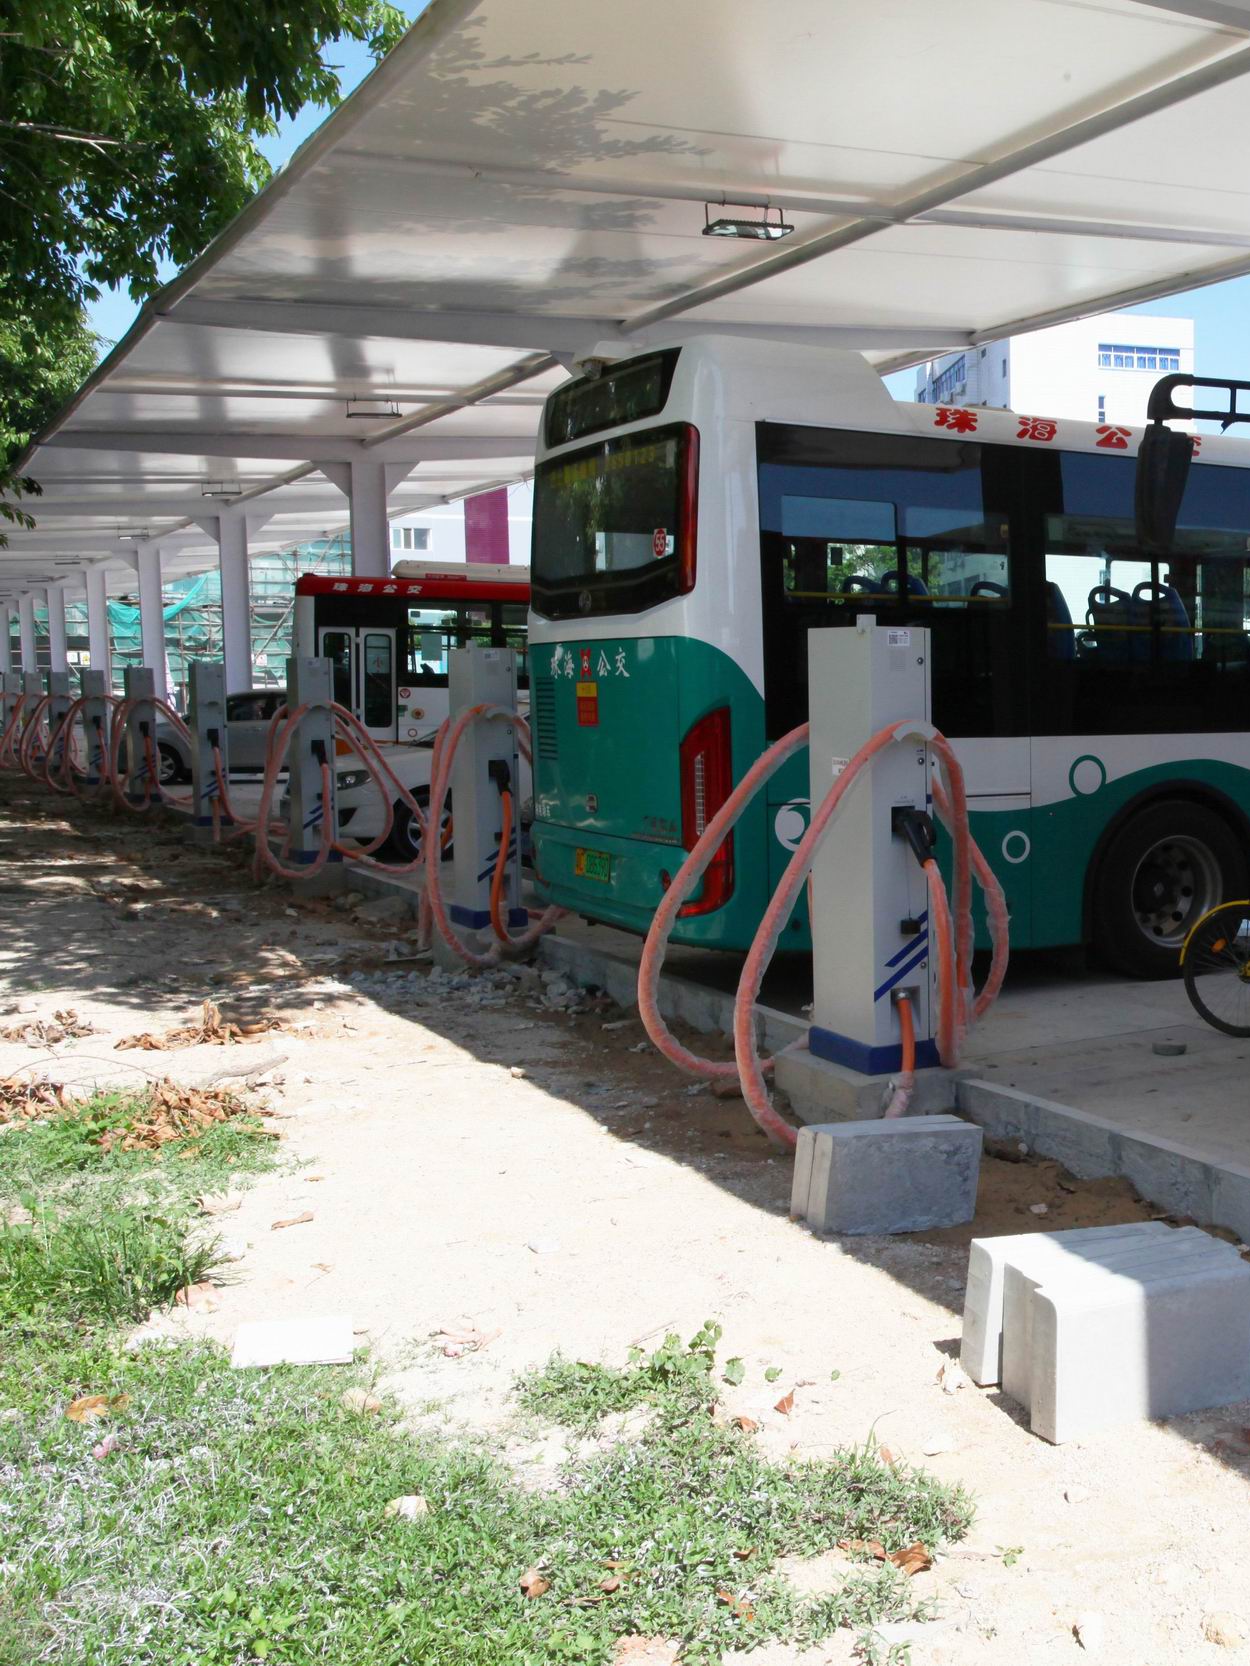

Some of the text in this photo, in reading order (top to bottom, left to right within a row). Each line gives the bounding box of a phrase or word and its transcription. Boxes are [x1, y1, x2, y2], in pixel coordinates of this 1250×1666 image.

[934, 406, 1201, 457] 珠海公
[333, 582, 423, 594] 珠海公交
